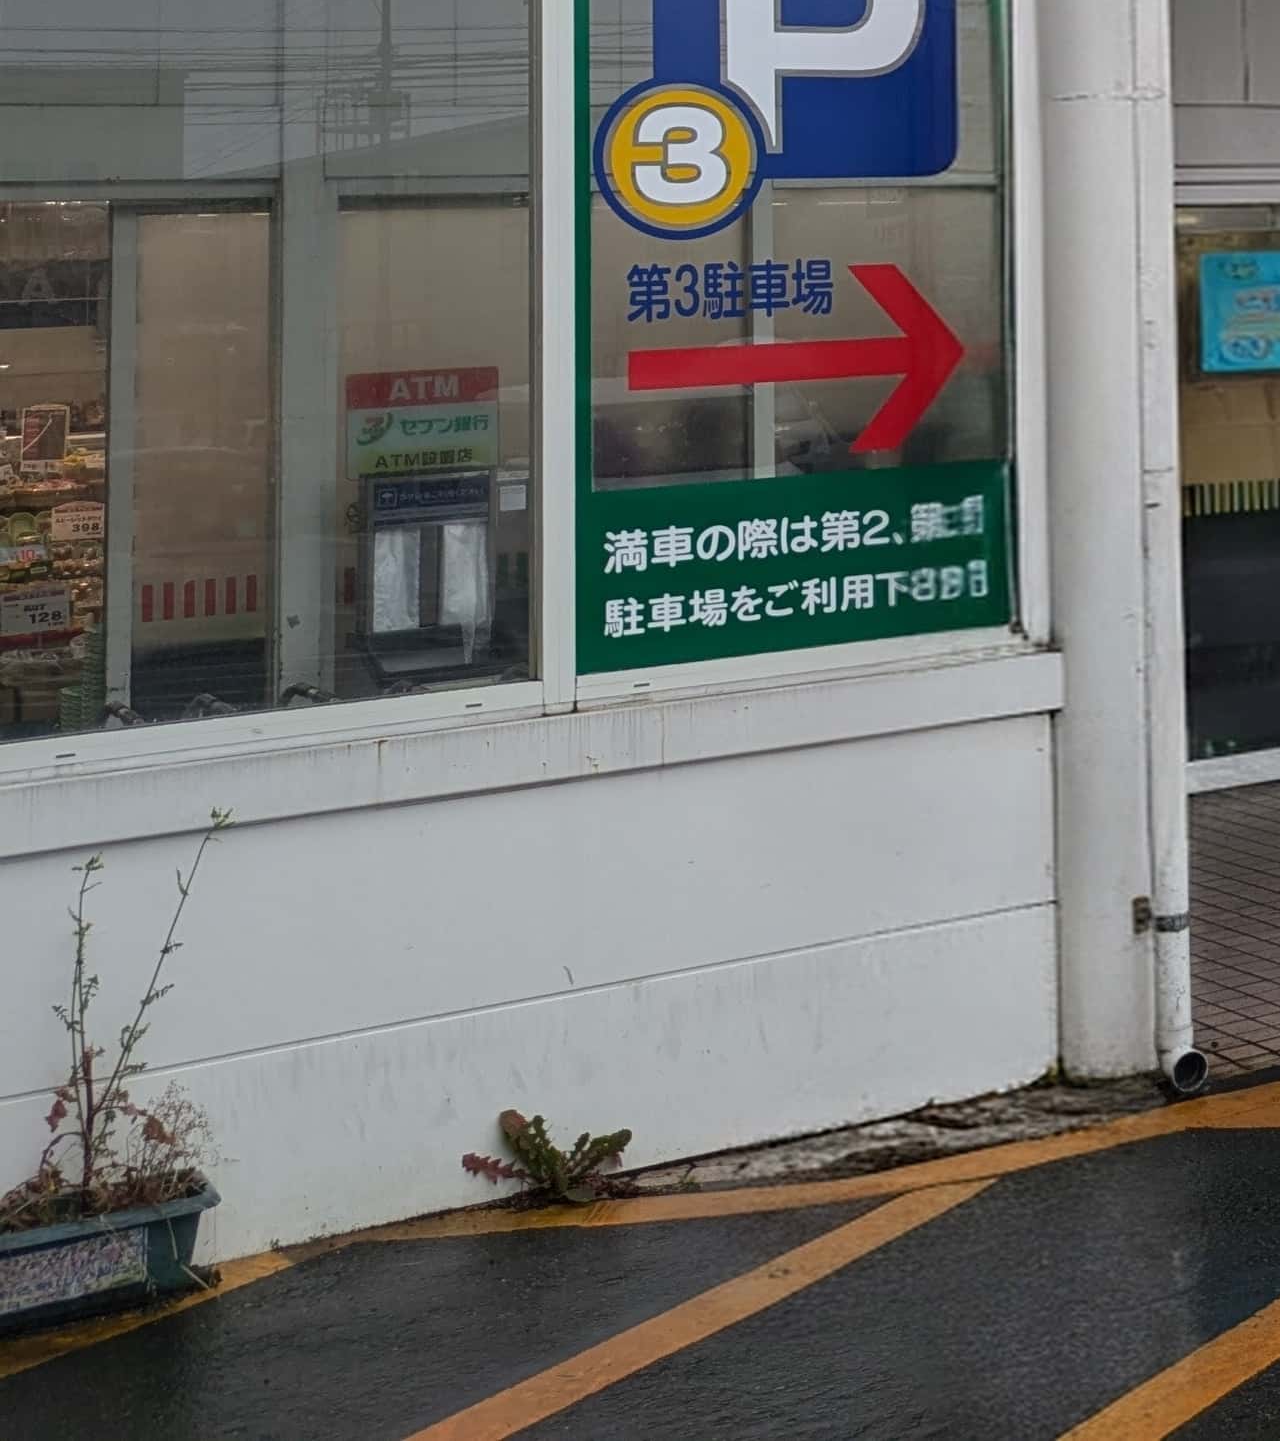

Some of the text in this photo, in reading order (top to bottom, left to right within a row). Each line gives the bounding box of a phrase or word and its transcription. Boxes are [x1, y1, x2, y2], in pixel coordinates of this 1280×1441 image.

[631, 103, 729, 206] 3
[626, 259, 834, 322] 第3駐車場
[389, 375, 460, 400] ATM
